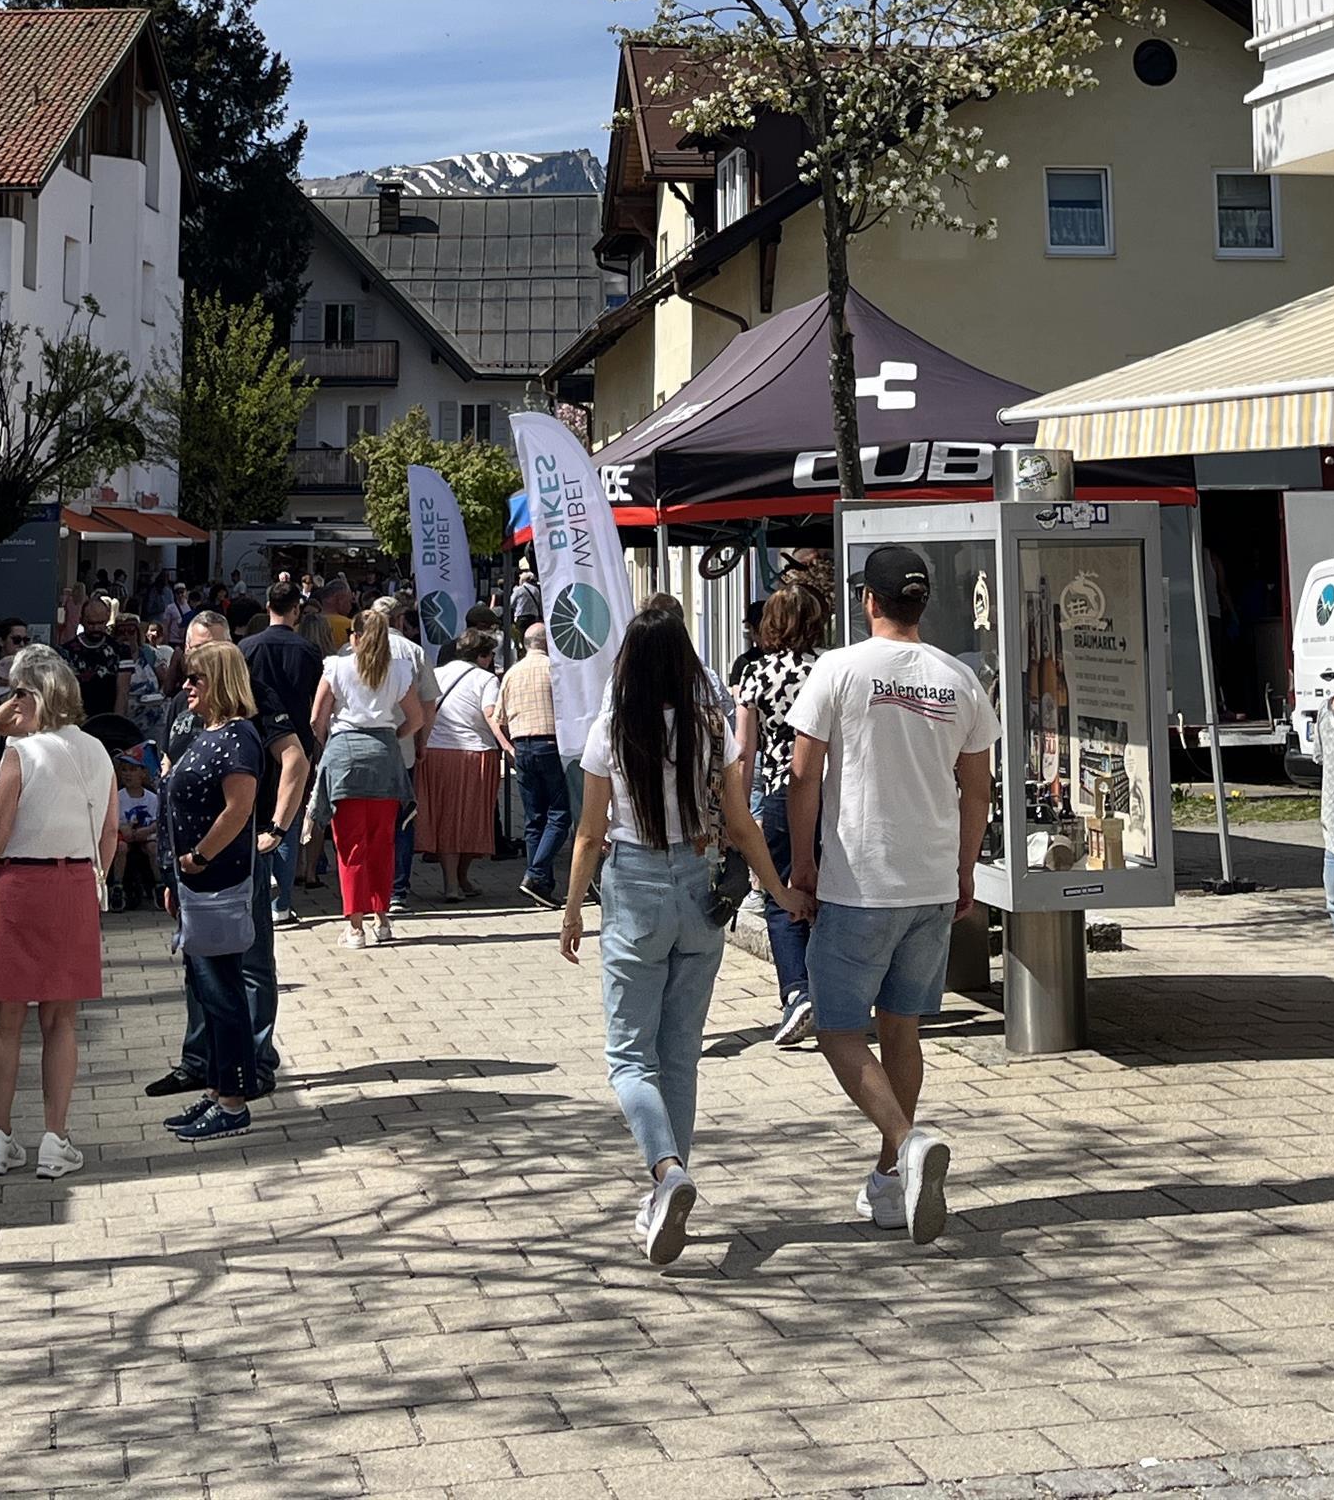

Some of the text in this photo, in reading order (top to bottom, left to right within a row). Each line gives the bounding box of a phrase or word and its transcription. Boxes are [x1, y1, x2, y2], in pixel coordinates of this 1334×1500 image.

[595, 464, 635, 501] BE
[793, 441, 1033, 489] CUB
[872, 678, 956, 704] Balenciaga
